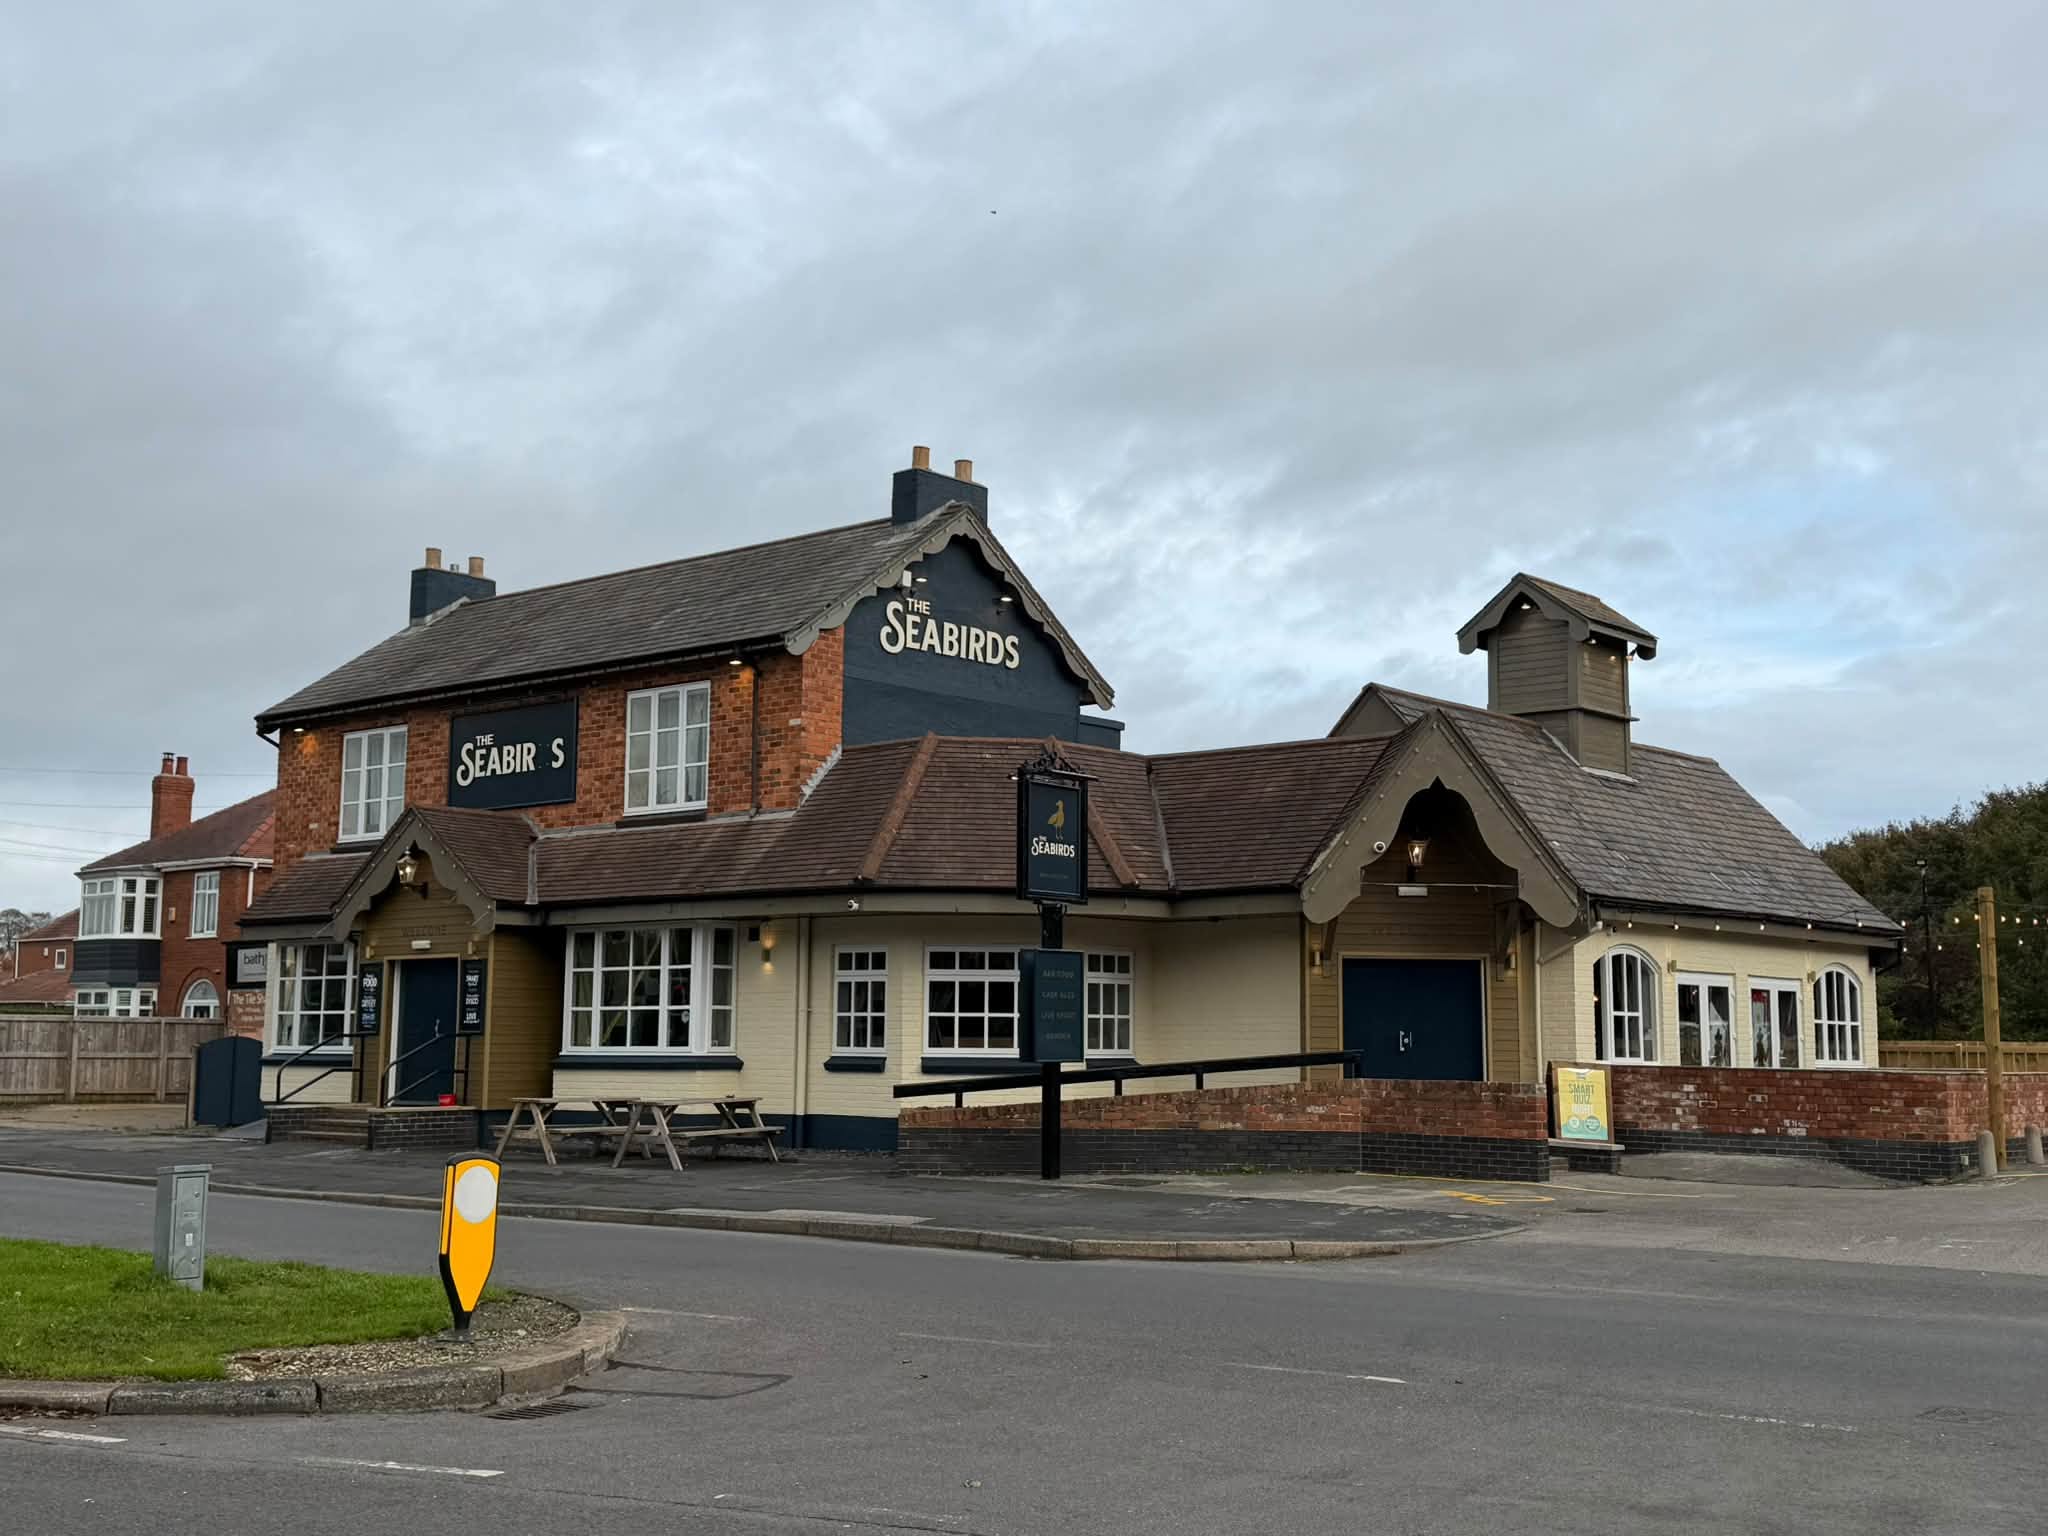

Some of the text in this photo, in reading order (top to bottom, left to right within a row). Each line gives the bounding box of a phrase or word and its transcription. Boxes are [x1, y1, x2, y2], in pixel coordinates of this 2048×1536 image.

[906, 597, 930, 615] THE
[880, 600, 1020, 669] SEABIRDS
[475, 734, 495, 746] THE
[1031, 837, 1075, 858] SEABIRDS
[1568, 1083, 1595, 1095] SMART
